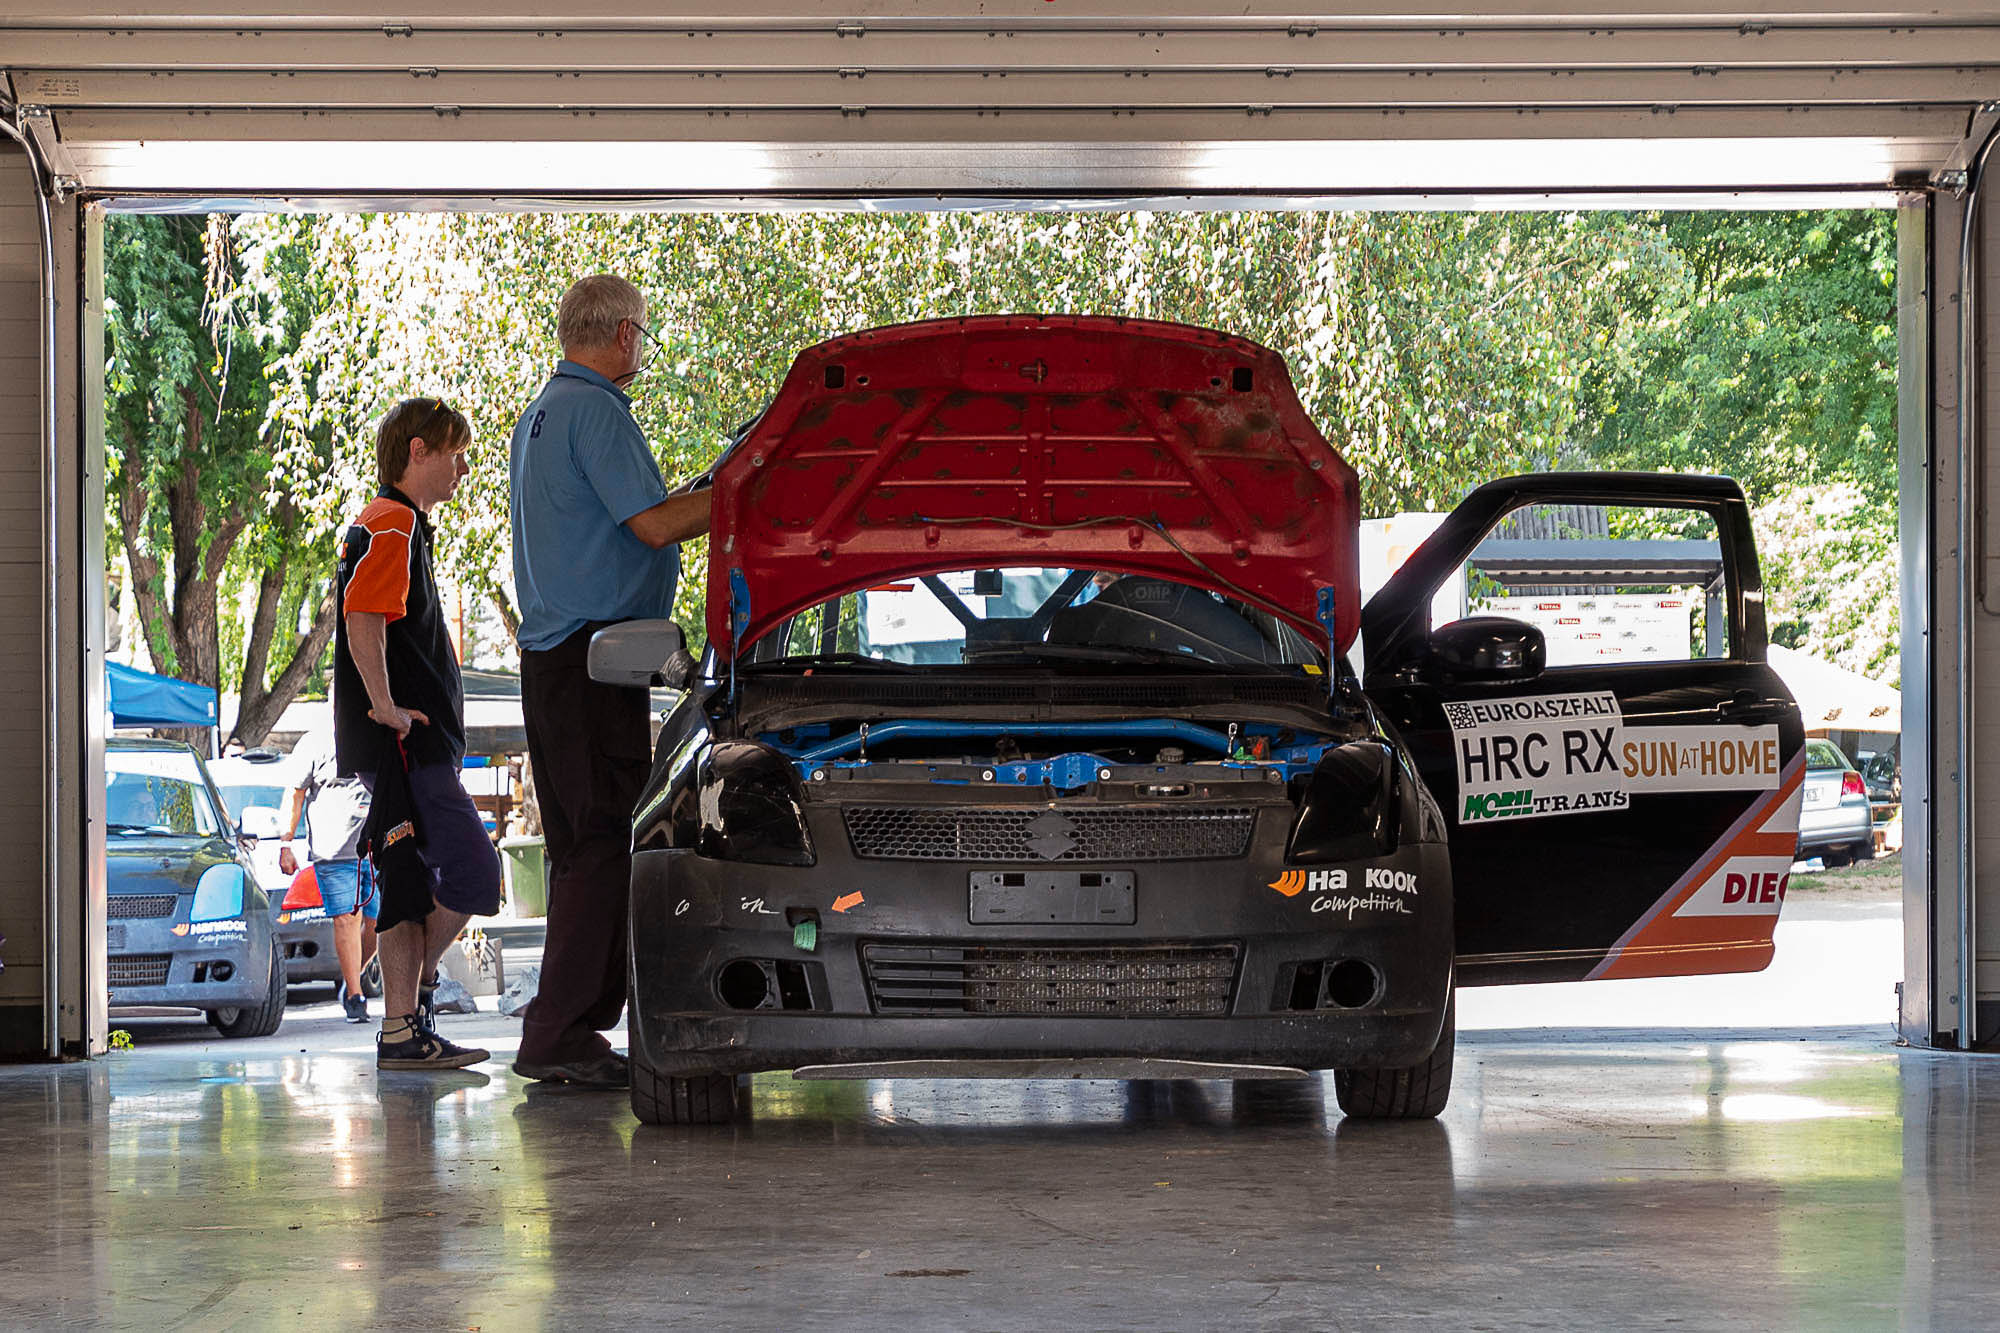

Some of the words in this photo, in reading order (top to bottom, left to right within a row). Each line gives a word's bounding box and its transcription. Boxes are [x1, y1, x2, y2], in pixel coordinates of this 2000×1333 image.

[1472, 696, 1617, 723] EUROASZFALT
[1461, 732, 1550, 784] HRC
[1562, 726, 1620, 775] RX
[1622, 742, 1678, 777] SUN
[1680, 748, 1700, 769] AT
[1700, 740, 1777, 776] HOME
[1310, 892, 1413, 920] Competition
